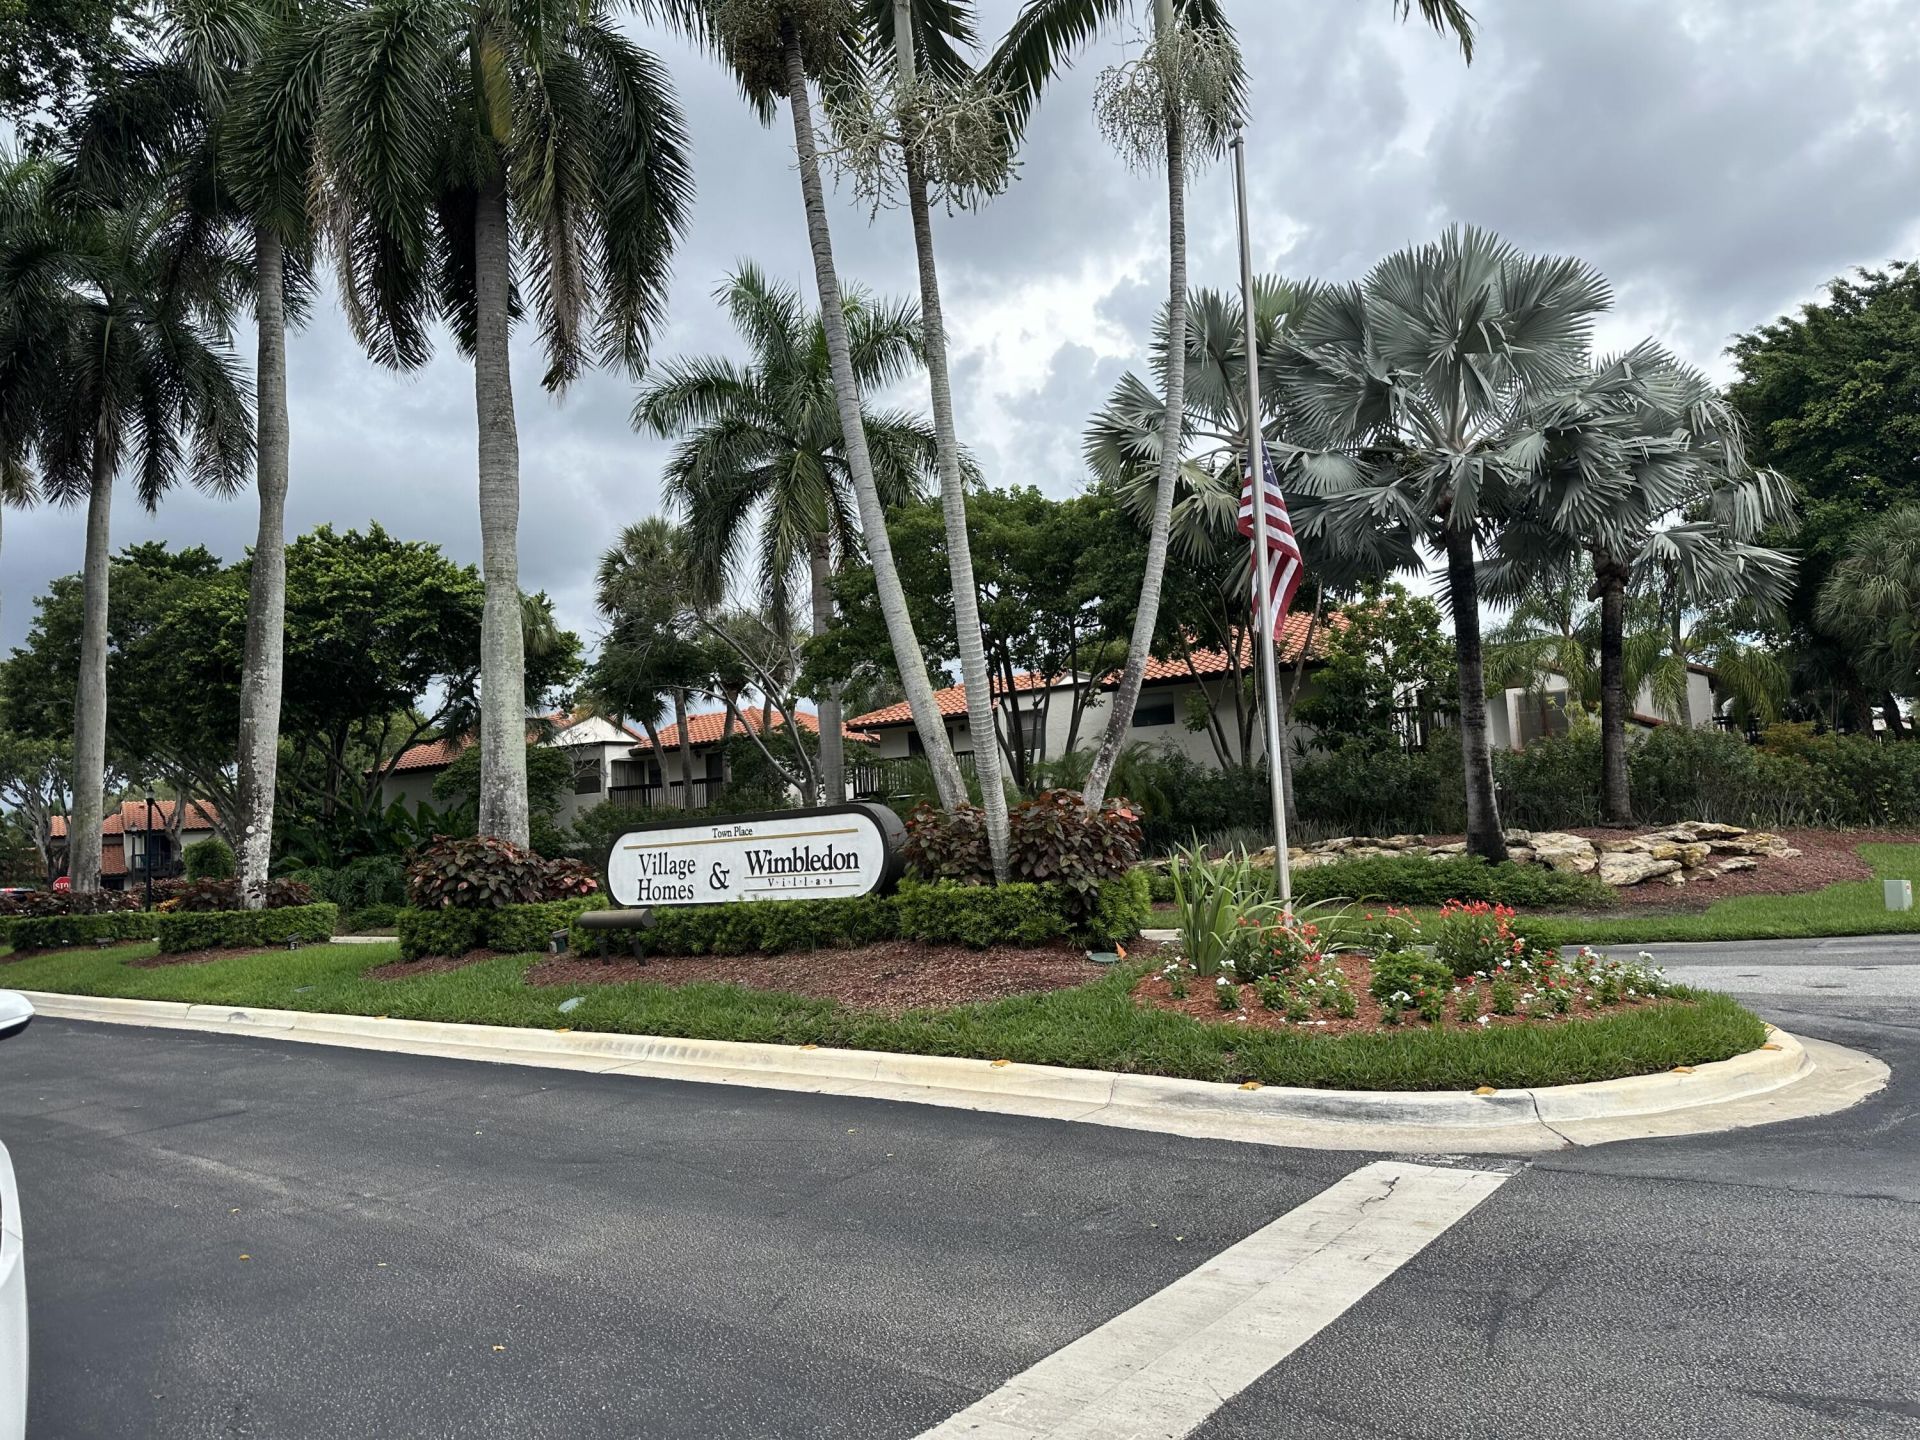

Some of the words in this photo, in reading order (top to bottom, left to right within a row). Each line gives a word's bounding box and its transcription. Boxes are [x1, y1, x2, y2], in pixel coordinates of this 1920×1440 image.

[712, 827, 732, 838] Town
[733, 826, 753, 837] Place
[638, 852, 696, 878] Village
[744, 844, 859, 876] Wimbledon
[54, 882, 70, 890] STO
[709, 862, 730, 890] &
[637, 878, 694, 901] Homes
